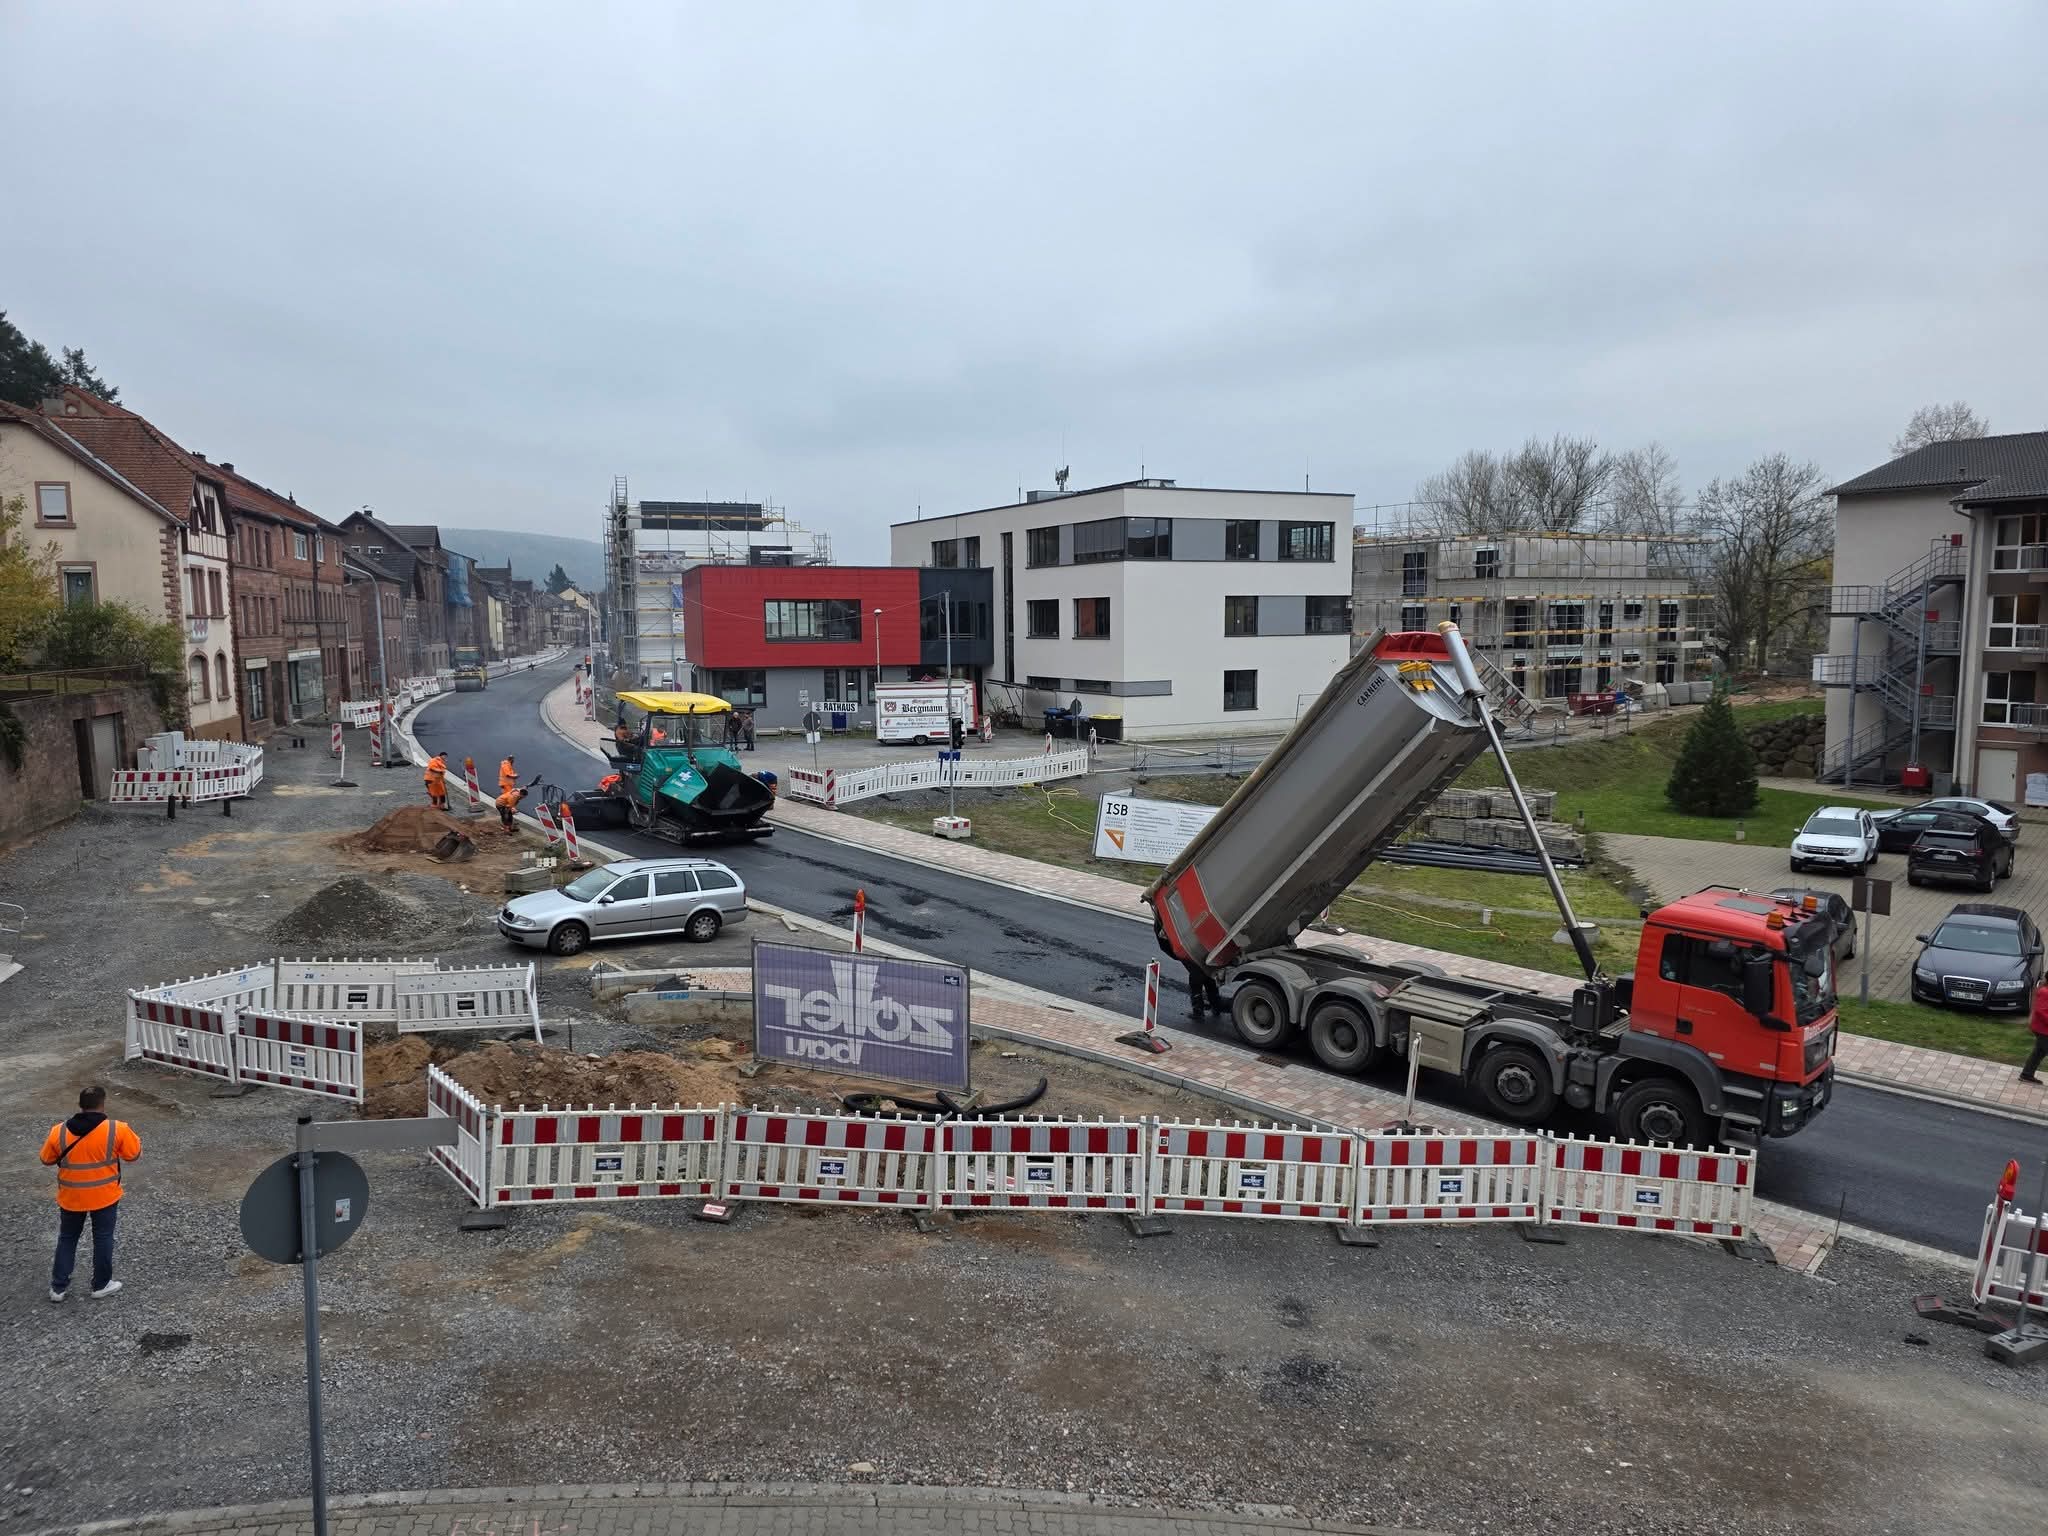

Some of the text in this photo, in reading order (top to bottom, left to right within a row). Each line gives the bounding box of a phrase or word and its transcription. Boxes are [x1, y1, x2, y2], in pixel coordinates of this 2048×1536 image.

[1357, 676, 1385, 706] CARNEHL
[823, 702, 856, 711] RATHAUS
[902, 703, 943, 714] Bergmann
[1106, 802, 1129, 816] ISB
